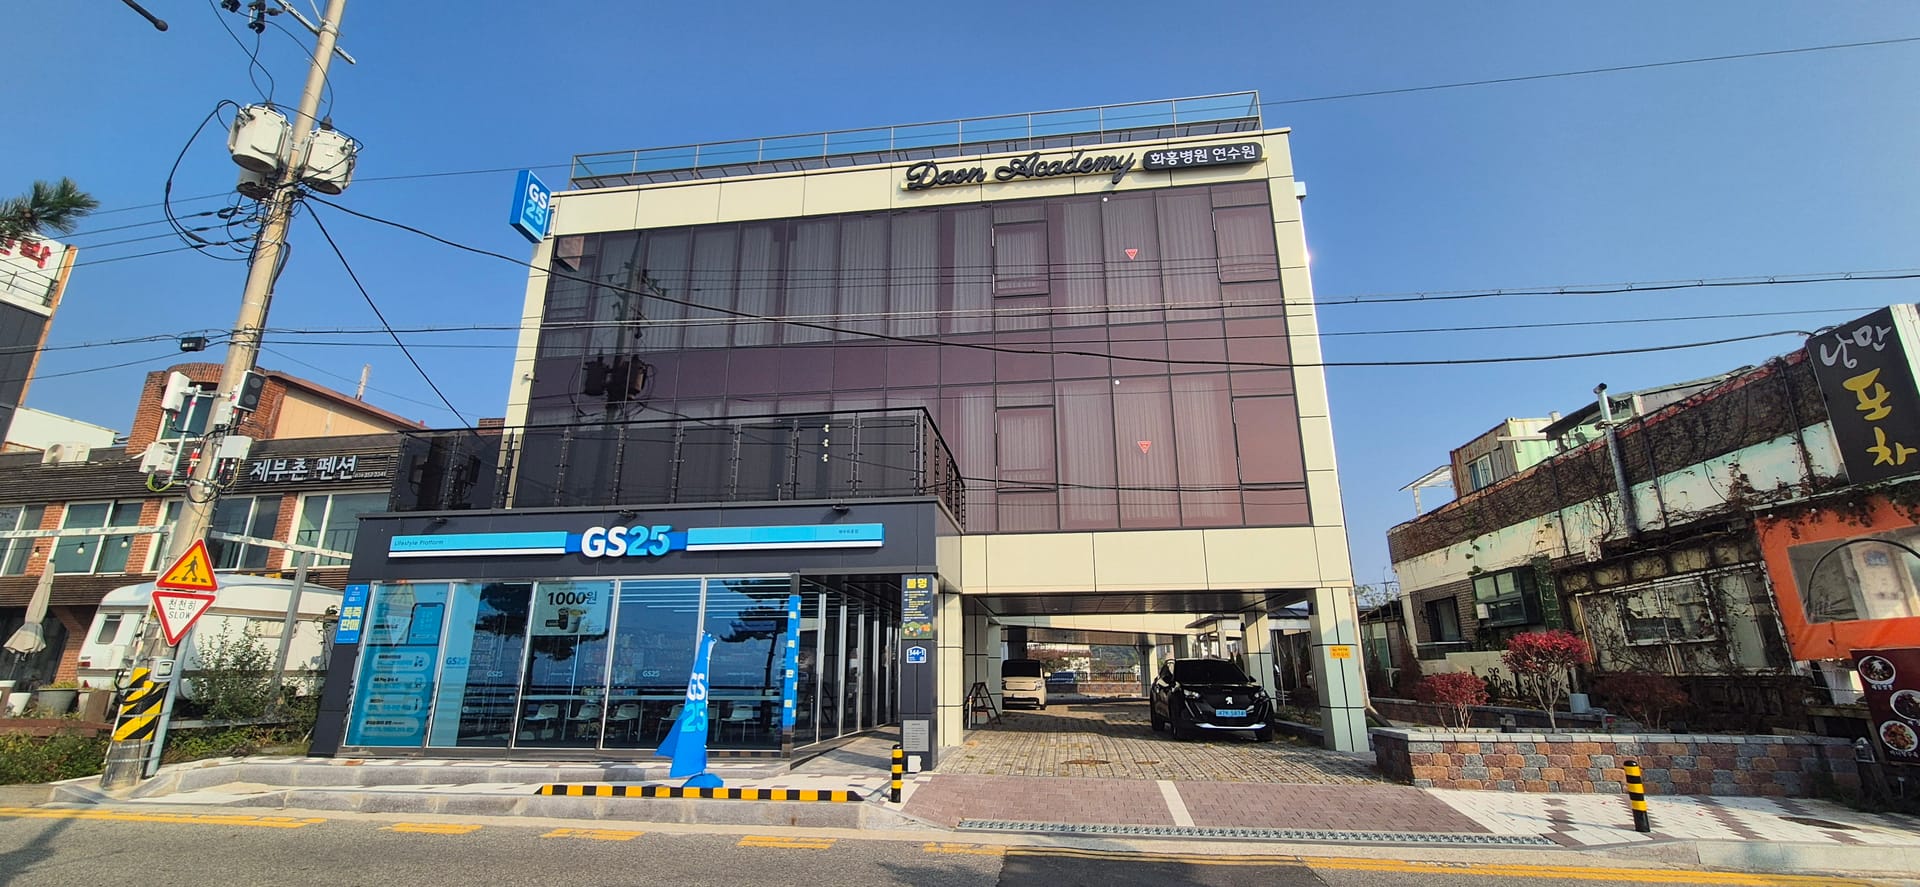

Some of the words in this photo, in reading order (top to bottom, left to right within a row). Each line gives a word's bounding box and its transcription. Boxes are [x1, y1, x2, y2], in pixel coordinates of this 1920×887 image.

[1150, 148, 1208, 166] 화홍병원
[1211, 144, 1256, 163] 연수원
[906, 160, 987, 190] Daon
[996, 150, 1137, 184] Academy
[528, 183, 548, 209] GS
[525, 200, 544, 225] 25
[1820, 325, 1891, 369] 낭만
[1842, 367, 1918, 467] 포차
[249, 457, 308, 482] 제부촌
[316, 454, 358, 480] 펜션
[581, 525, 672, 557] GS25
[168, 598, 197, 611] 천천히
[547, 590, 598, 611] 1000원
[168, 611, 192, 620] SLOW
[446, 656, 466, 666] GS25
[642, 669, 657, 677] GS25
[686, 672, 706, 701] GS
[681, 702, 706, 733] 25
